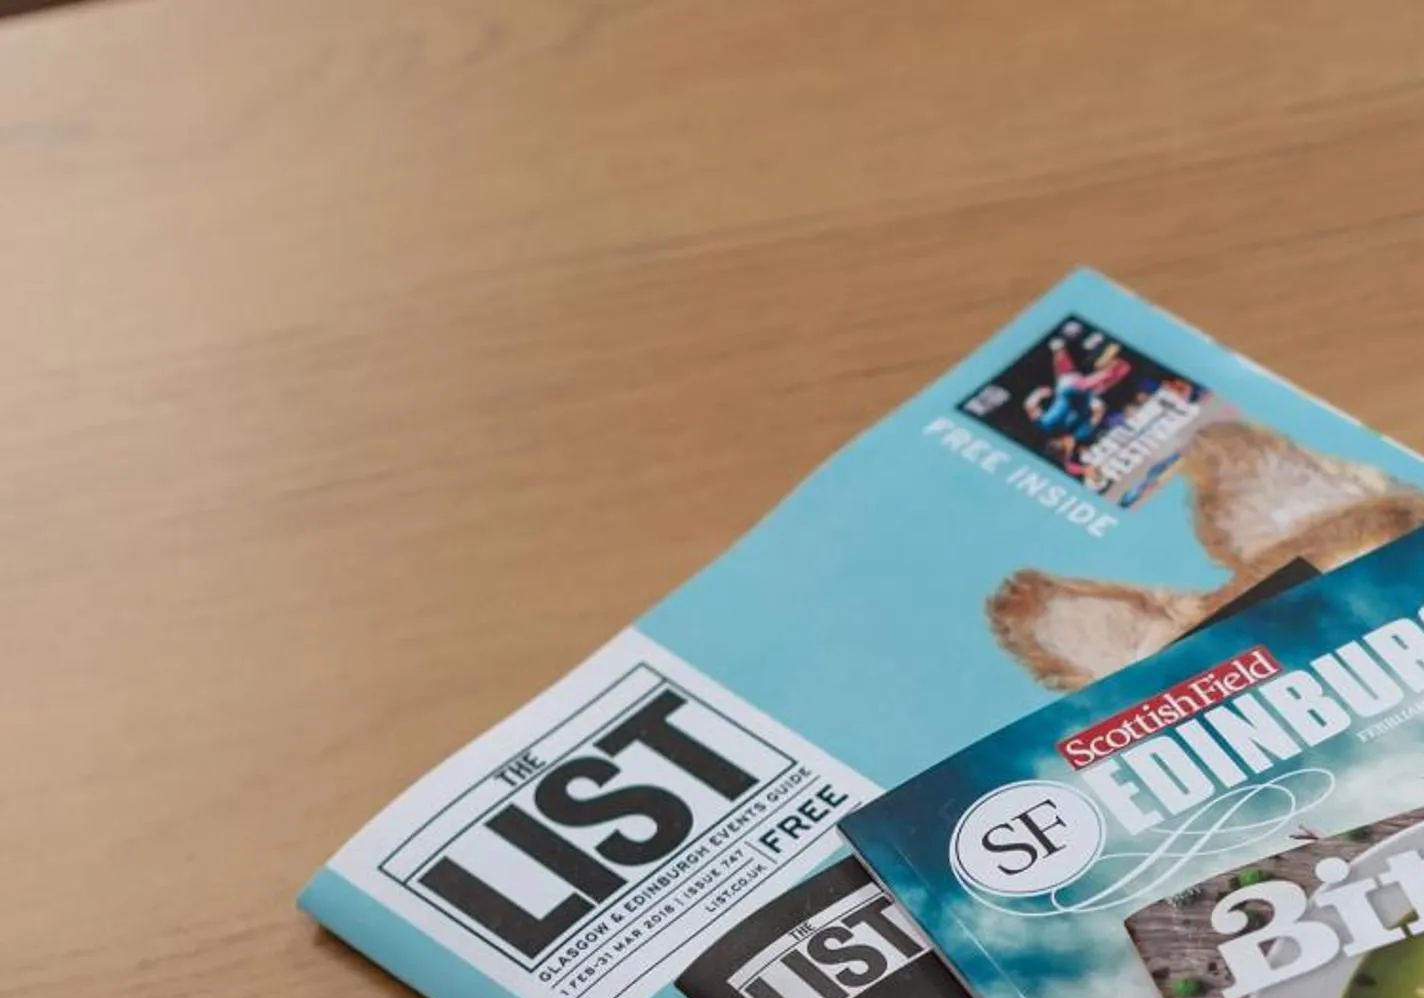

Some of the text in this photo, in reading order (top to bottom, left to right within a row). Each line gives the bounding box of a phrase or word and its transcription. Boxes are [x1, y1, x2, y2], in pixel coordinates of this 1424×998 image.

[922, 418, 1119, 538] FREE INSIDE
[1064, 651, 1278, 769] Scottish Field
[493, 751, 548, 788] THE
[417, 688, 760, 960] LIST
[759, 784, 848, 854] FREE
[981, 799, 1067, 875] SF
[538, 767, 812, 983] GLASGOW & EDINBURGH EVENTS GUIDE
[612, 929, 642, 952] MAR
[643, 905, 677, 929] 2018
[683, 868, 722, 899] ISSUE
[720, 849, 745, 869] 747
[705, 863, 768, 913] LIST.CO.UK
[788, 922, 815, 941] THE
